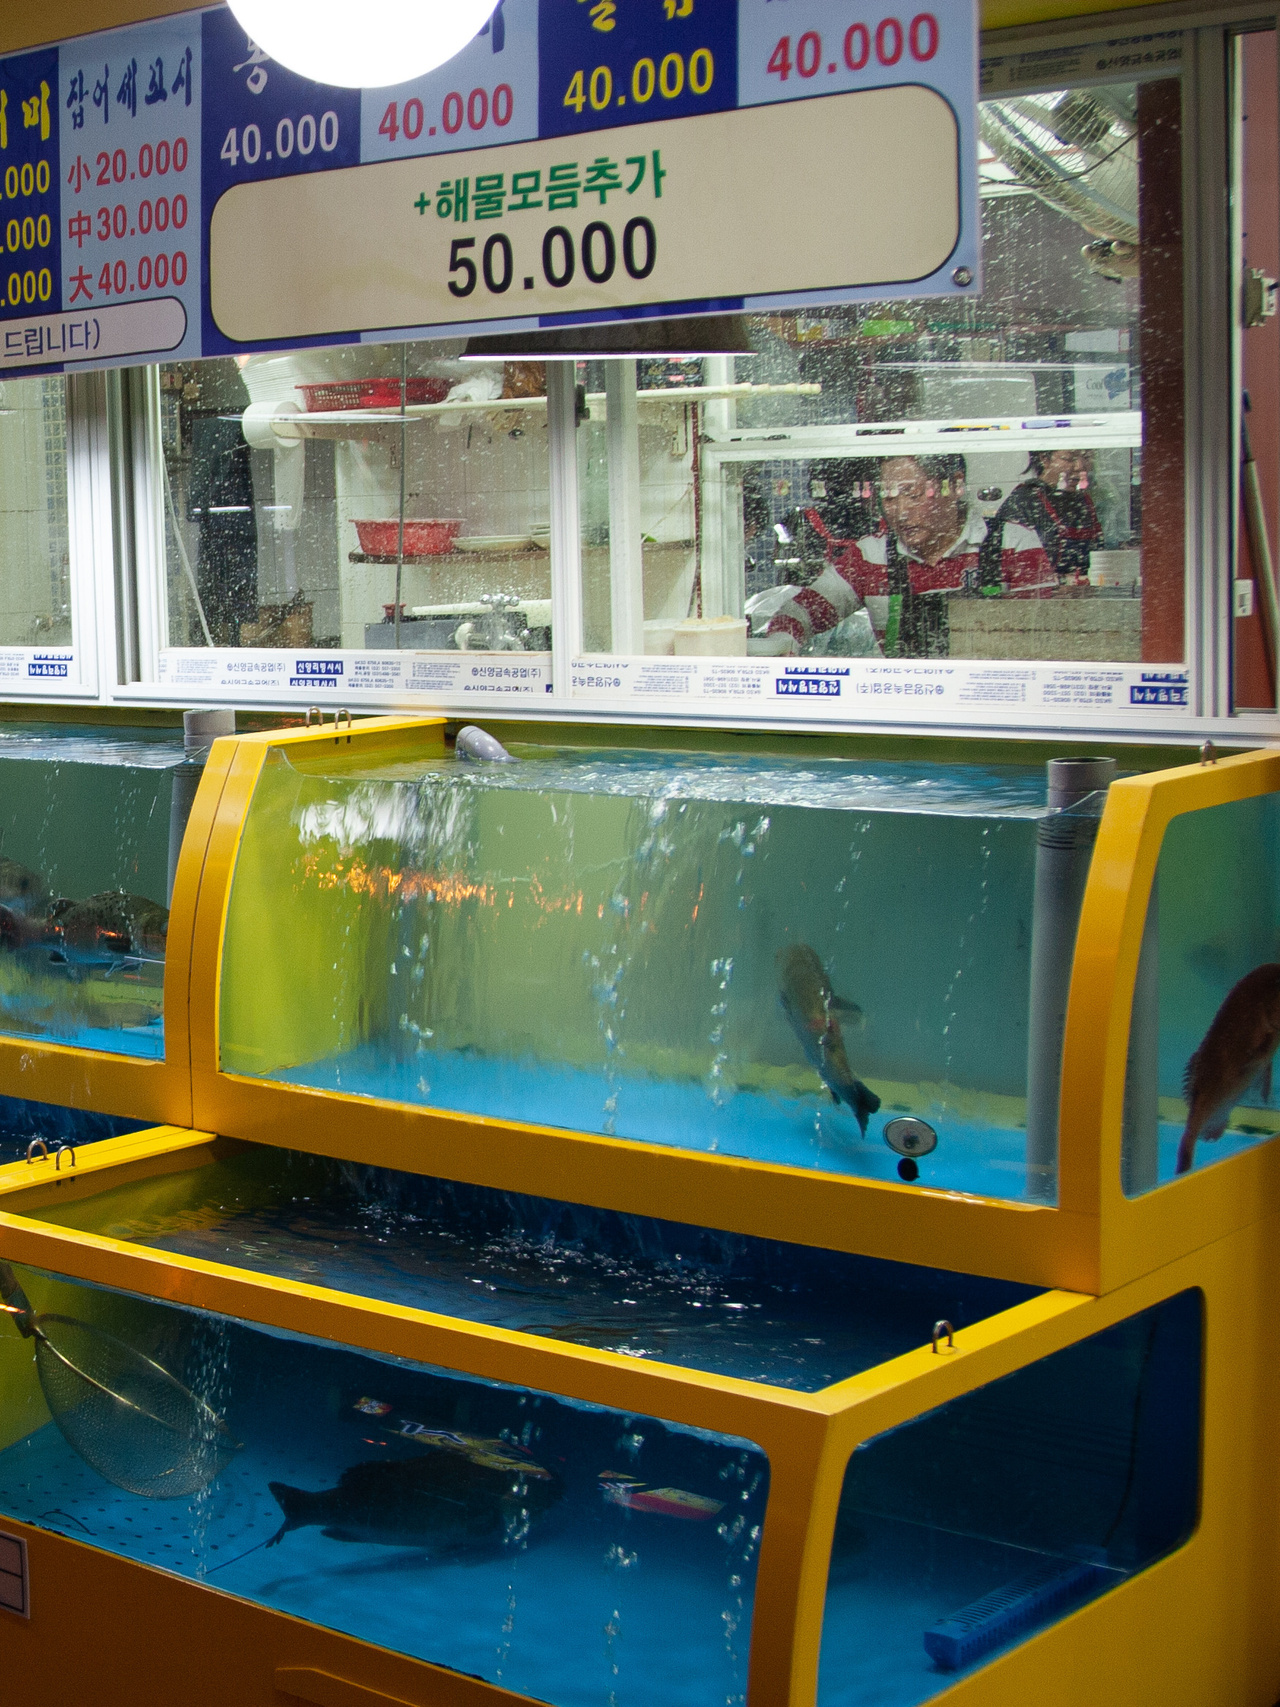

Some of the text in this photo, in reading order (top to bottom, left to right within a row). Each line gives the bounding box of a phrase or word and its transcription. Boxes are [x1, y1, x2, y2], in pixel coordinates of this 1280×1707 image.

[766, 12, 940, 81] 40.000
[563, 47, 714, 114] 40.000
[220, 110, 339, 167] 40.000
[377, 83, 514, 142] 40.000
[447, 214, 658, 298] 50.000
[4, 318, 102, 360] 드립니다)
